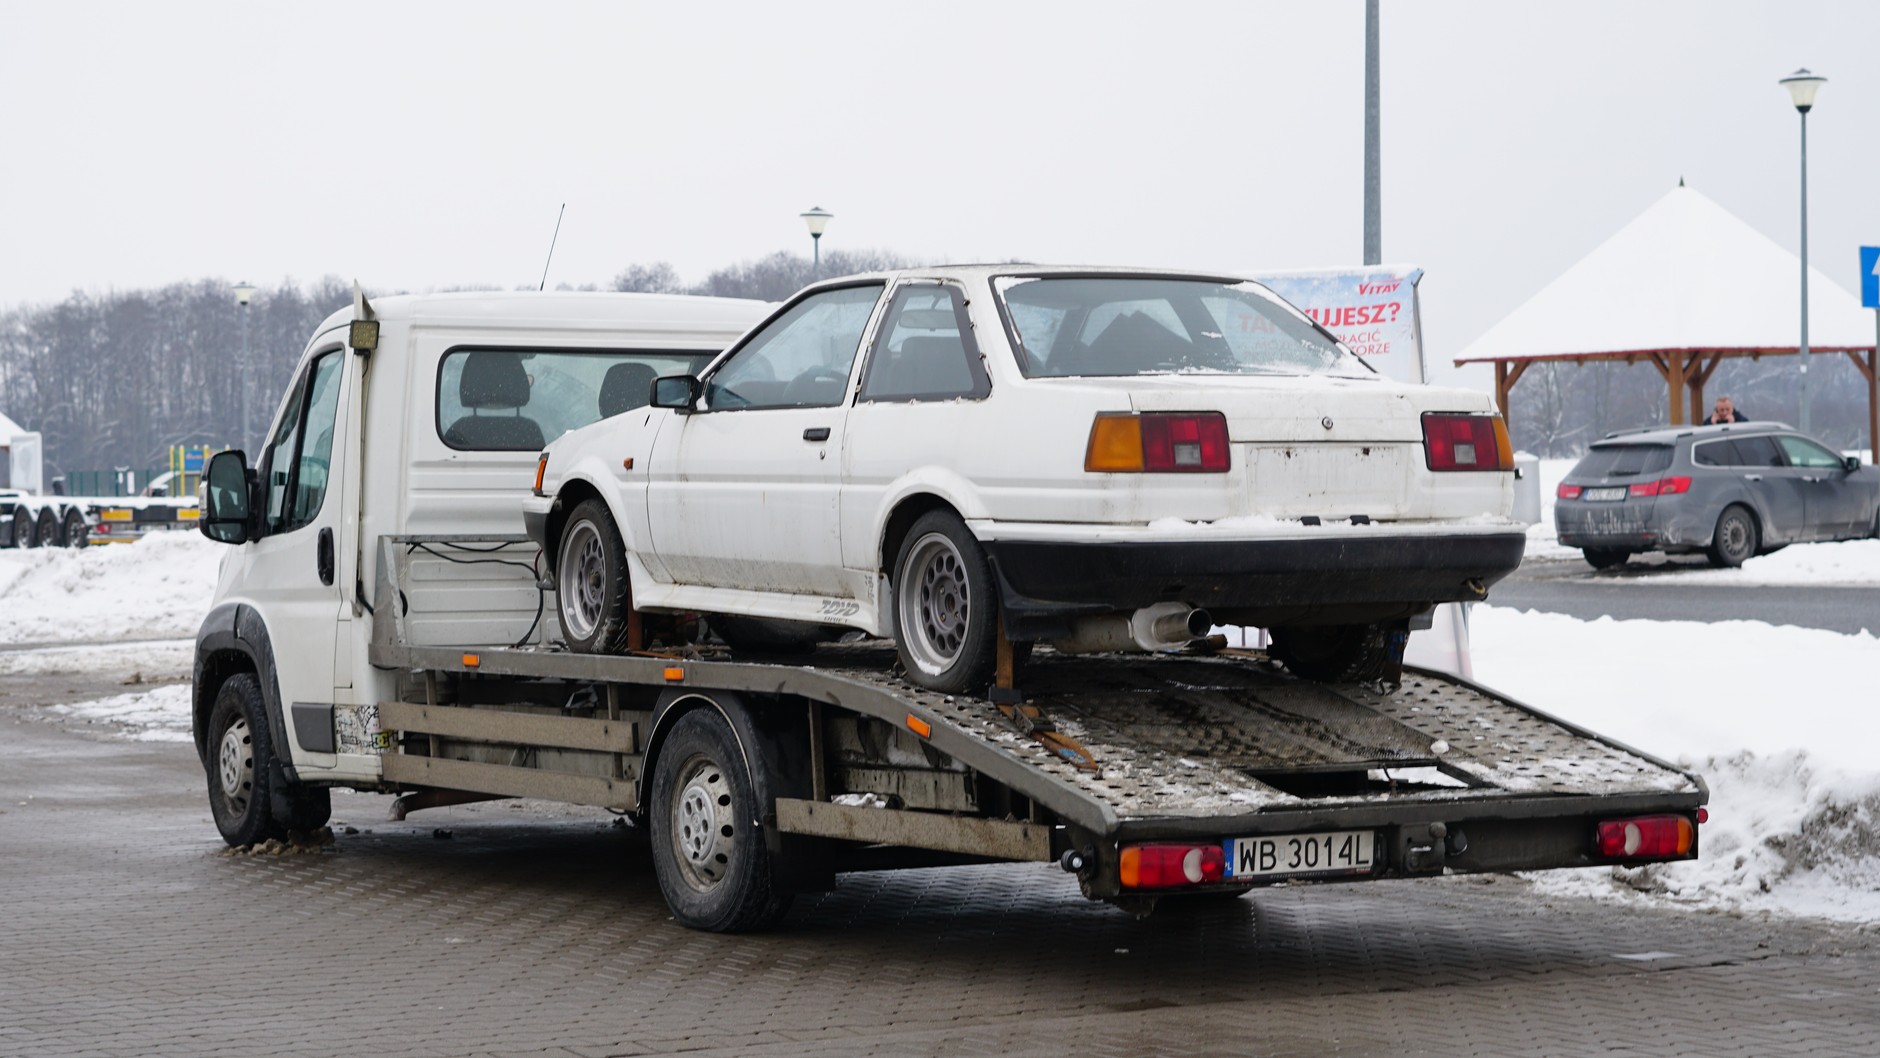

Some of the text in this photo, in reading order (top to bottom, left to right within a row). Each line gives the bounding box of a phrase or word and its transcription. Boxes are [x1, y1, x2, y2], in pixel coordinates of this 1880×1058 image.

[1359, 282, 1400, 296] VITAY
[1240, 834, 1370, 872] WB 3014L
